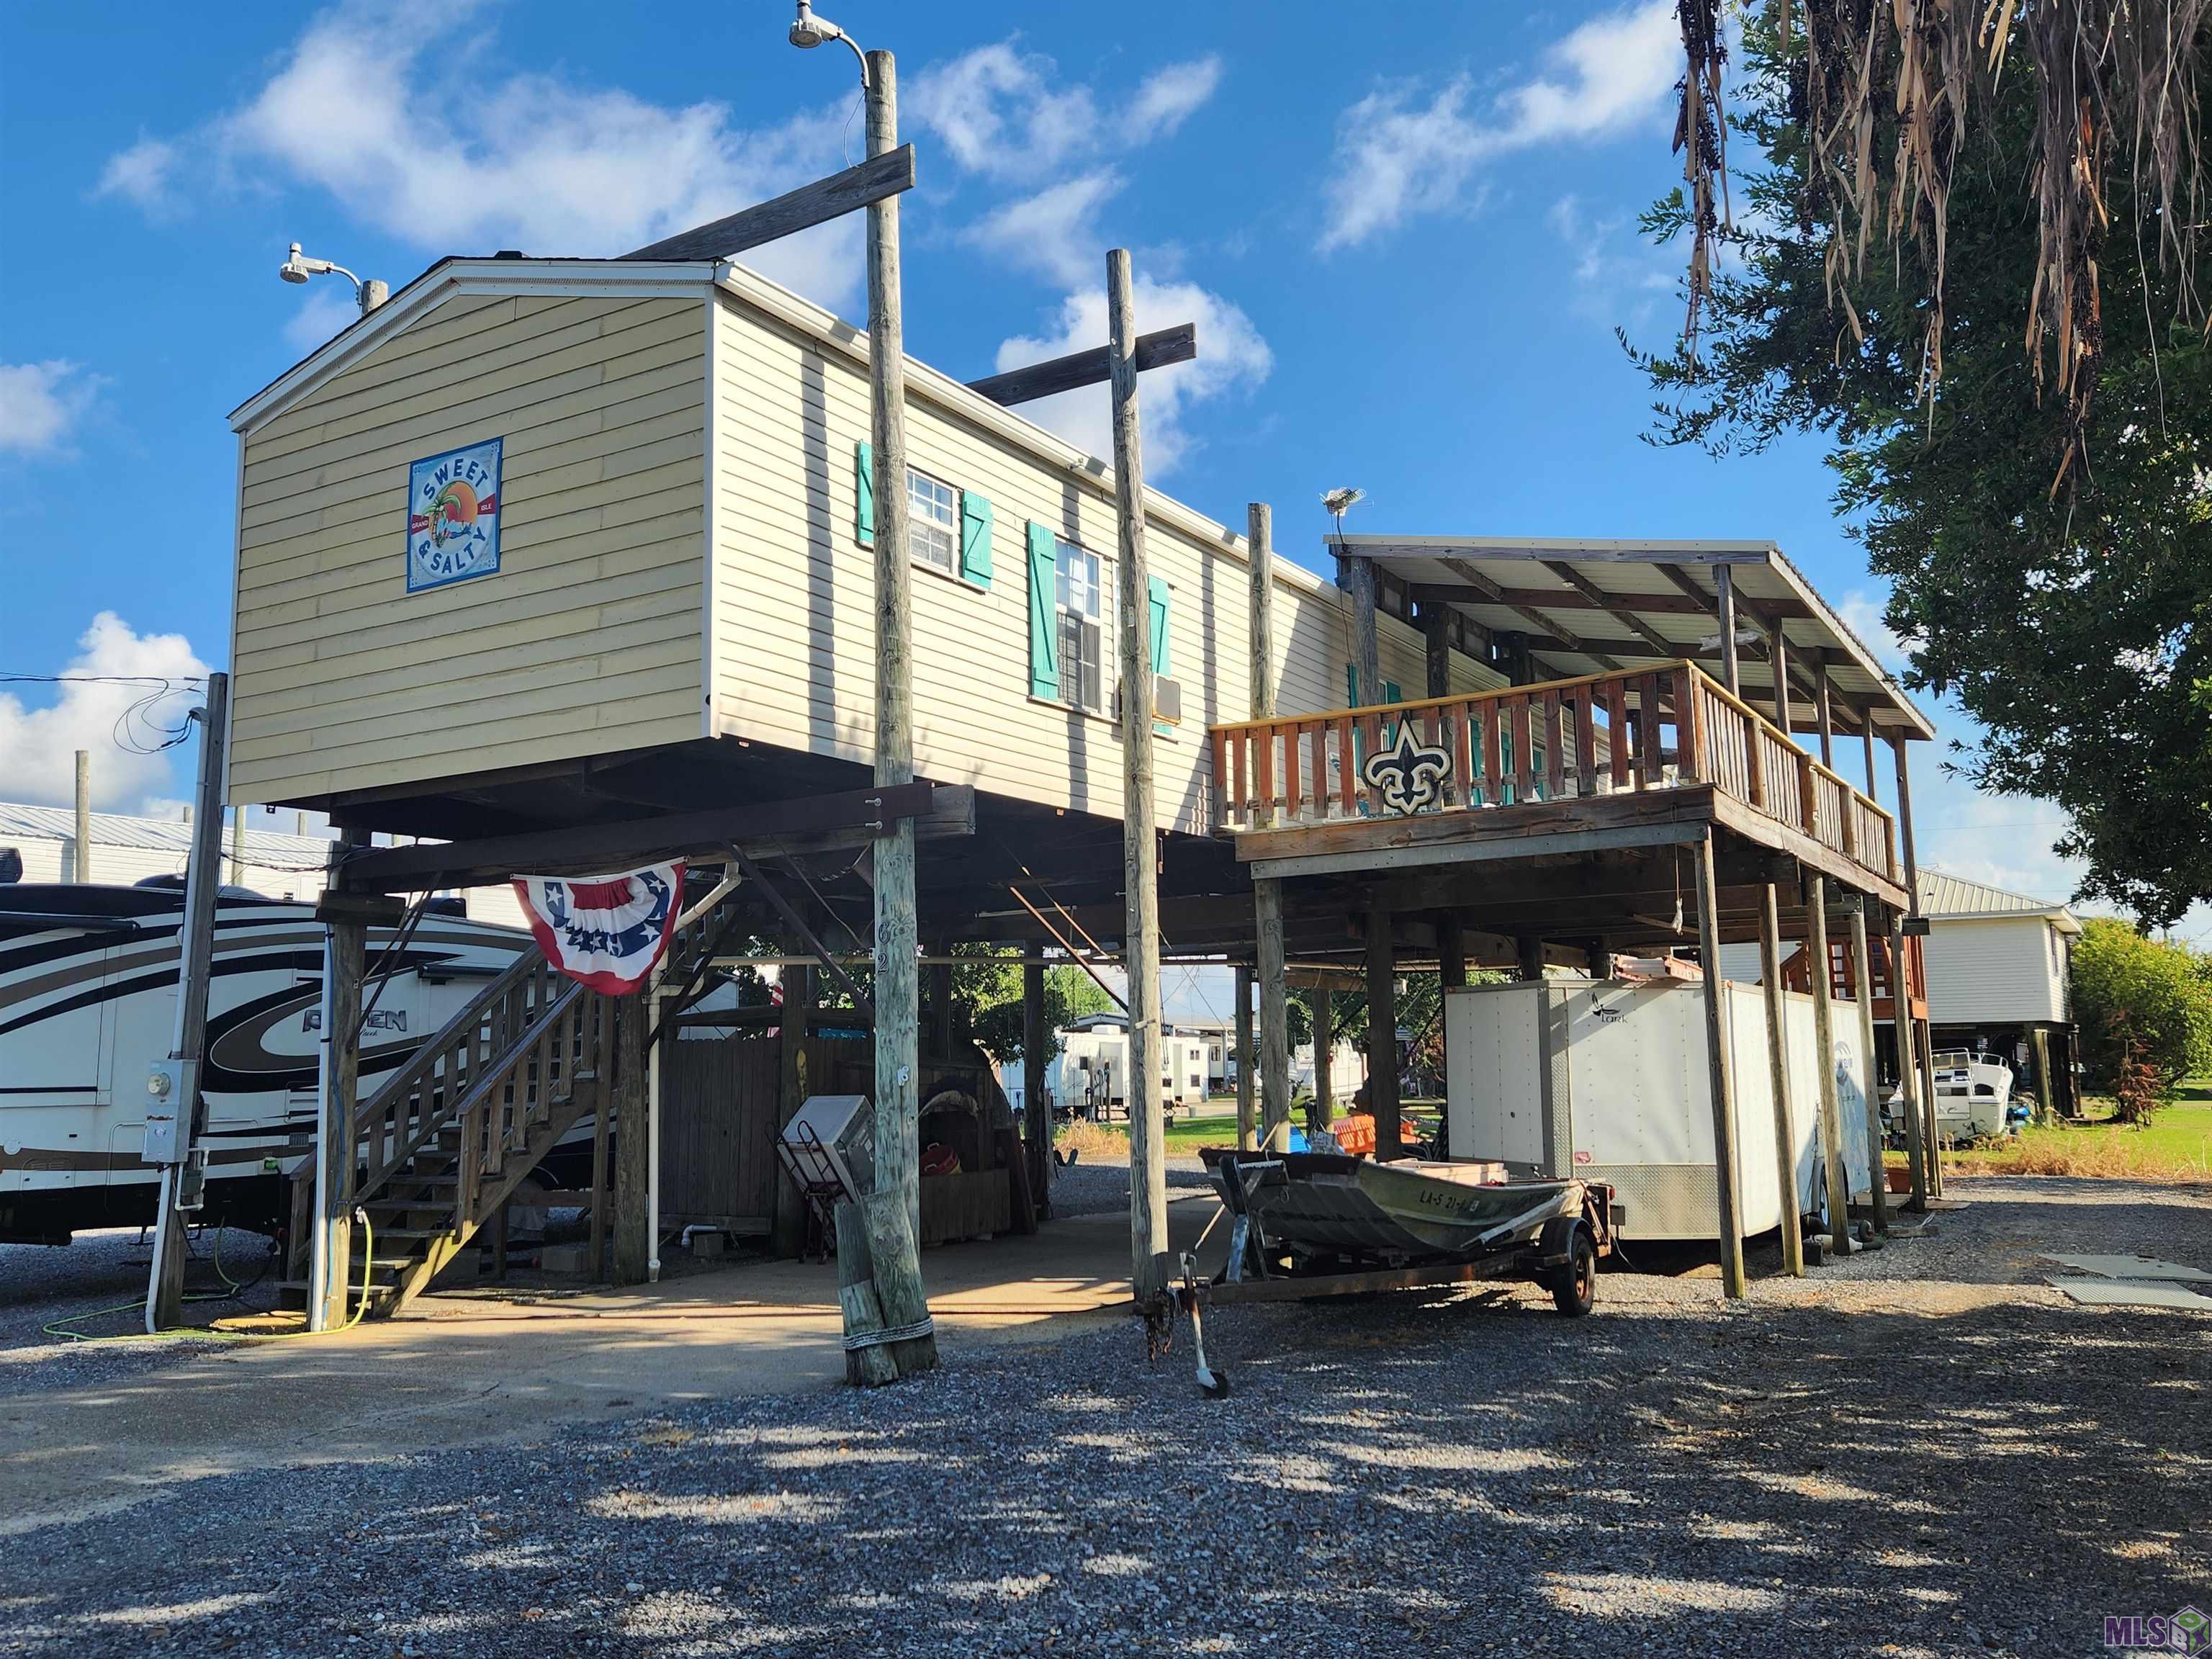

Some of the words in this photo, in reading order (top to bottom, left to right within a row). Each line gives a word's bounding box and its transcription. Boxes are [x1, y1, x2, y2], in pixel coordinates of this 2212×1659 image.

[423, 458, 488, 500] SWEET
[411, 520, 429, 529] GRAND
[418, 540, 431, 559] &
[431, 526, 486, 574] SALTY
[878, 893, 891, 974] 162
